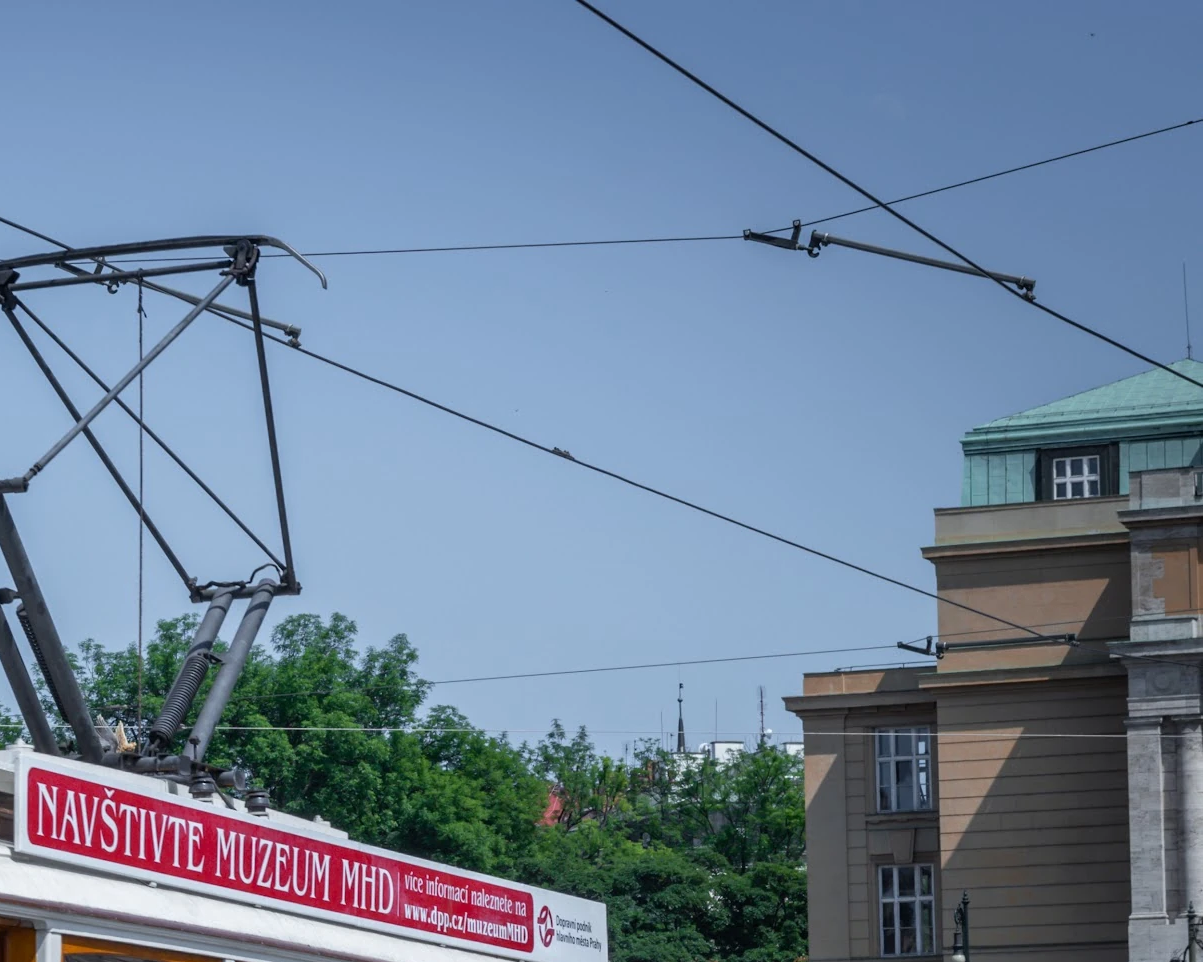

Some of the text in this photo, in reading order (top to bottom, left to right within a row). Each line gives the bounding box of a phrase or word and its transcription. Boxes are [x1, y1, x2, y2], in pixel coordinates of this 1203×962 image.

[36, 782, 395, 915] NAVŠTIVTE MUZEUM MHD
[404, 871, 527, 917] více informací naleznete na
[404, 903, 529, 944] www.dpp.cz/muzeumMHD
